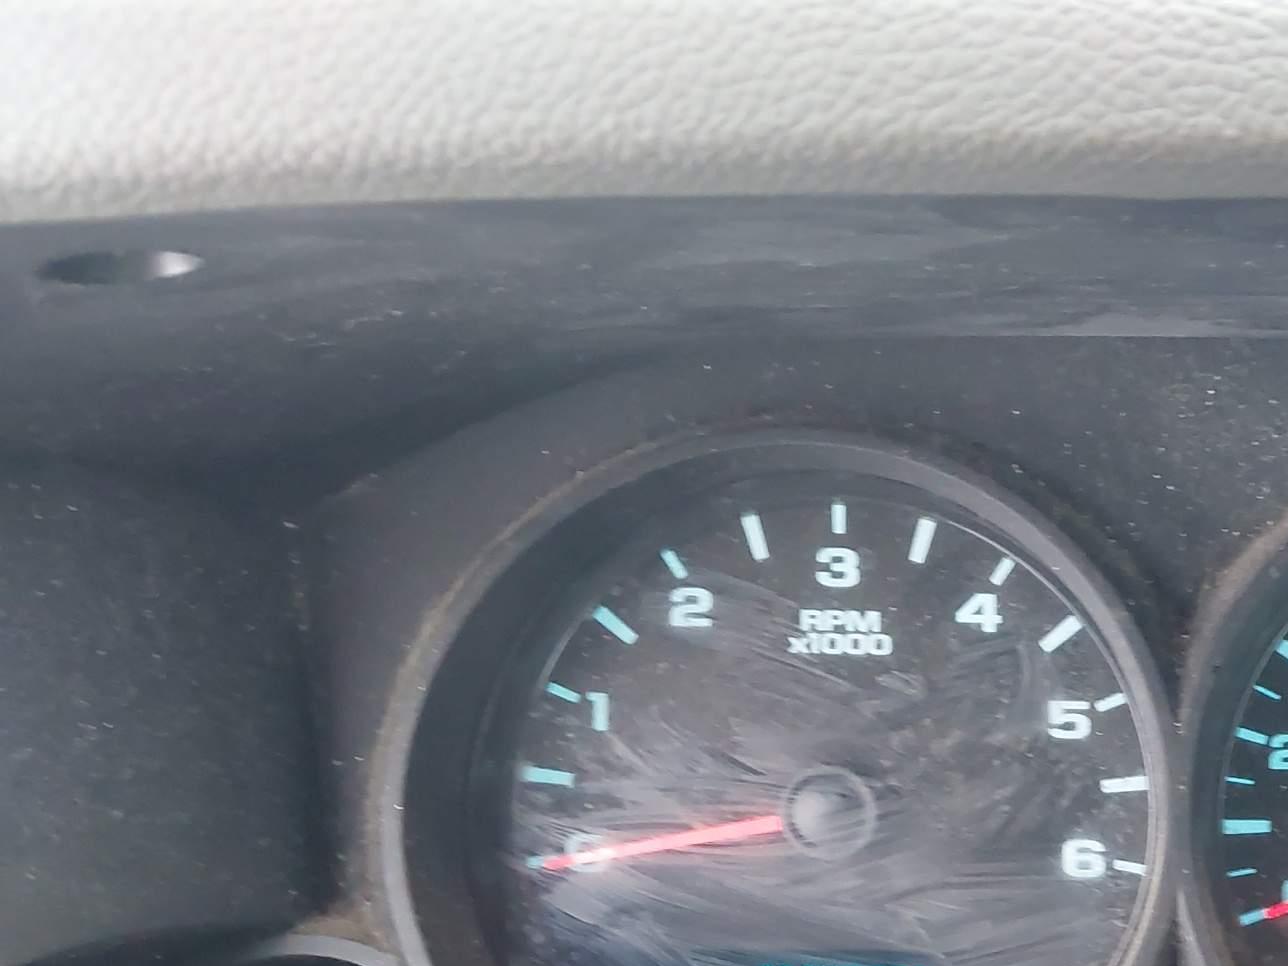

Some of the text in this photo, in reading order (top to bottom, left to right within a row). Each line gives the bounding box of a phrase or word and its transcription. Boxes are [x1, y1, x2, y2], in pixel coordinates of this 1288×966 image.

[815, 548, 861, 587] 3
[668, 586, 714, 628] 2
[799, 609, 883, 632] RPM
[955, 593, 1003, 633] 4
[786, 633, 893, 655] x1000
[586, 692, 610, 731] 1
[1047, 700, 1093, 740] 5
[1061, 838, 1107, 878] 6
